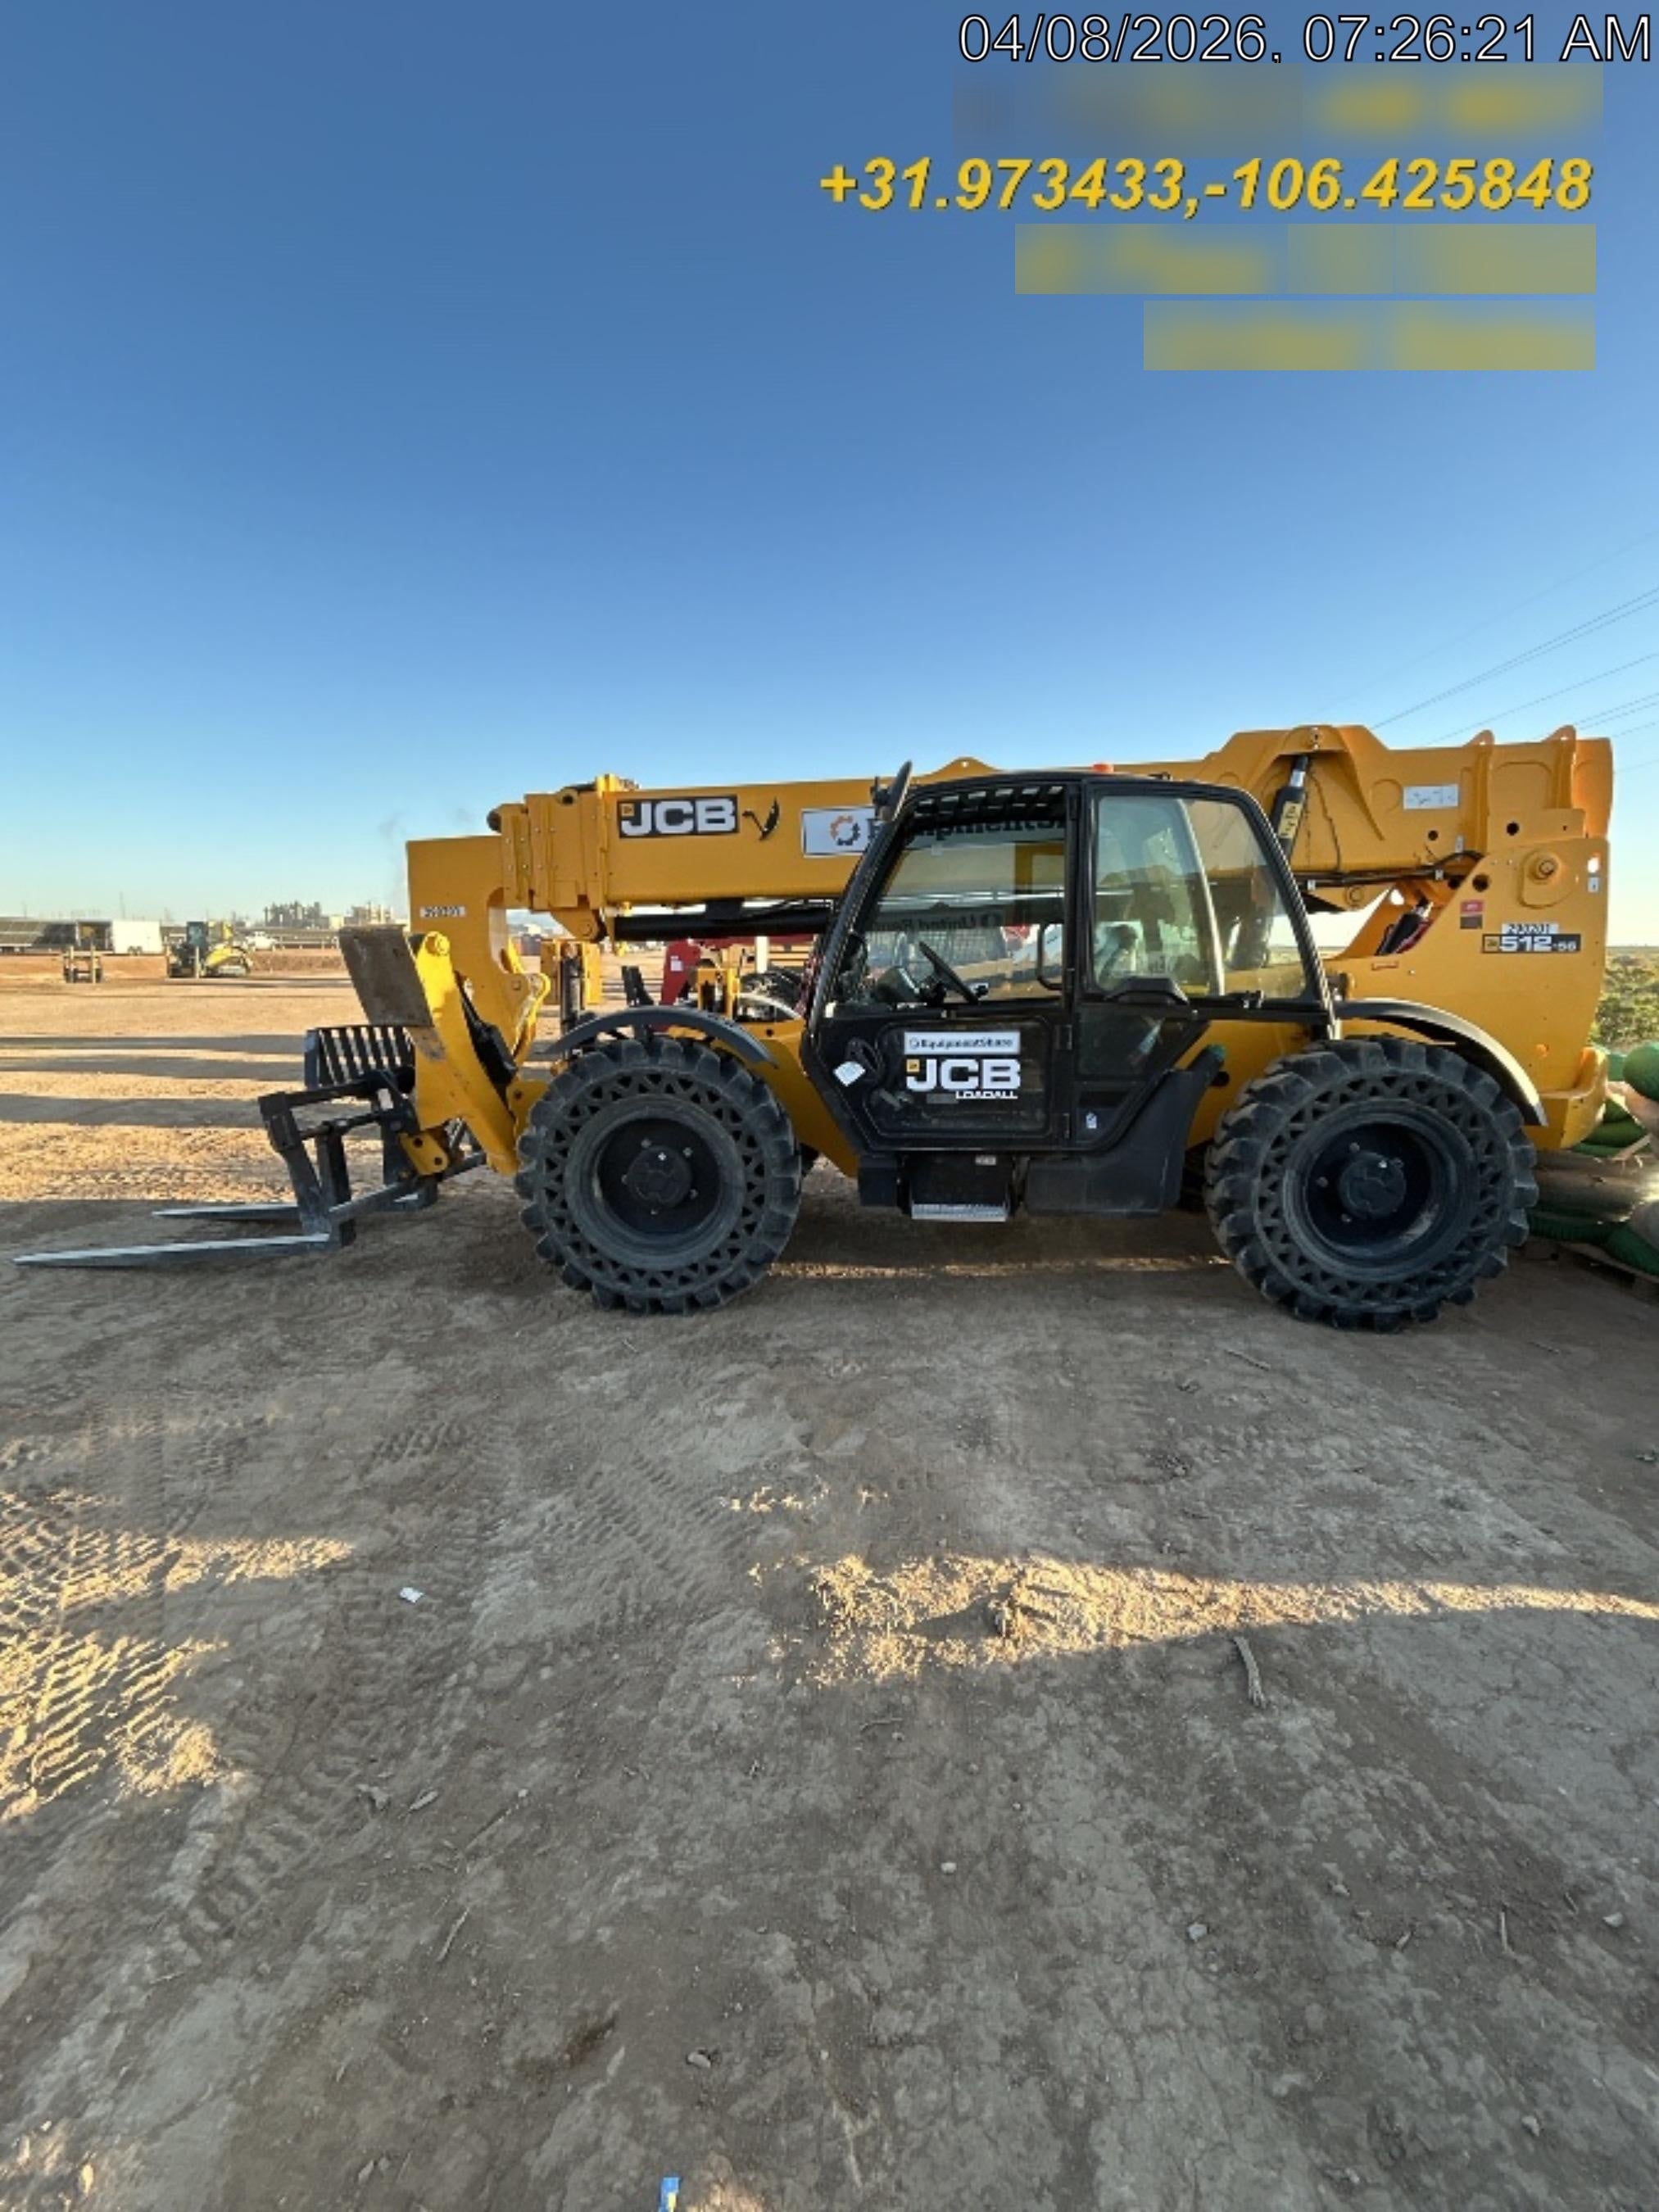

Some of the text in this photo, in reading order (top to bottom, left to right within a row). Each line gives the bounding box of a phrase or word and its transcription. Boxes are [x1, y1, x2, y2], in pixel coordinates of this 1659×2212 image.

[620, 798, 736, 836] JCB
[906, 1059, 1021, 1090] JCB
[955, 1090, 1018, 1099] LOADALL
